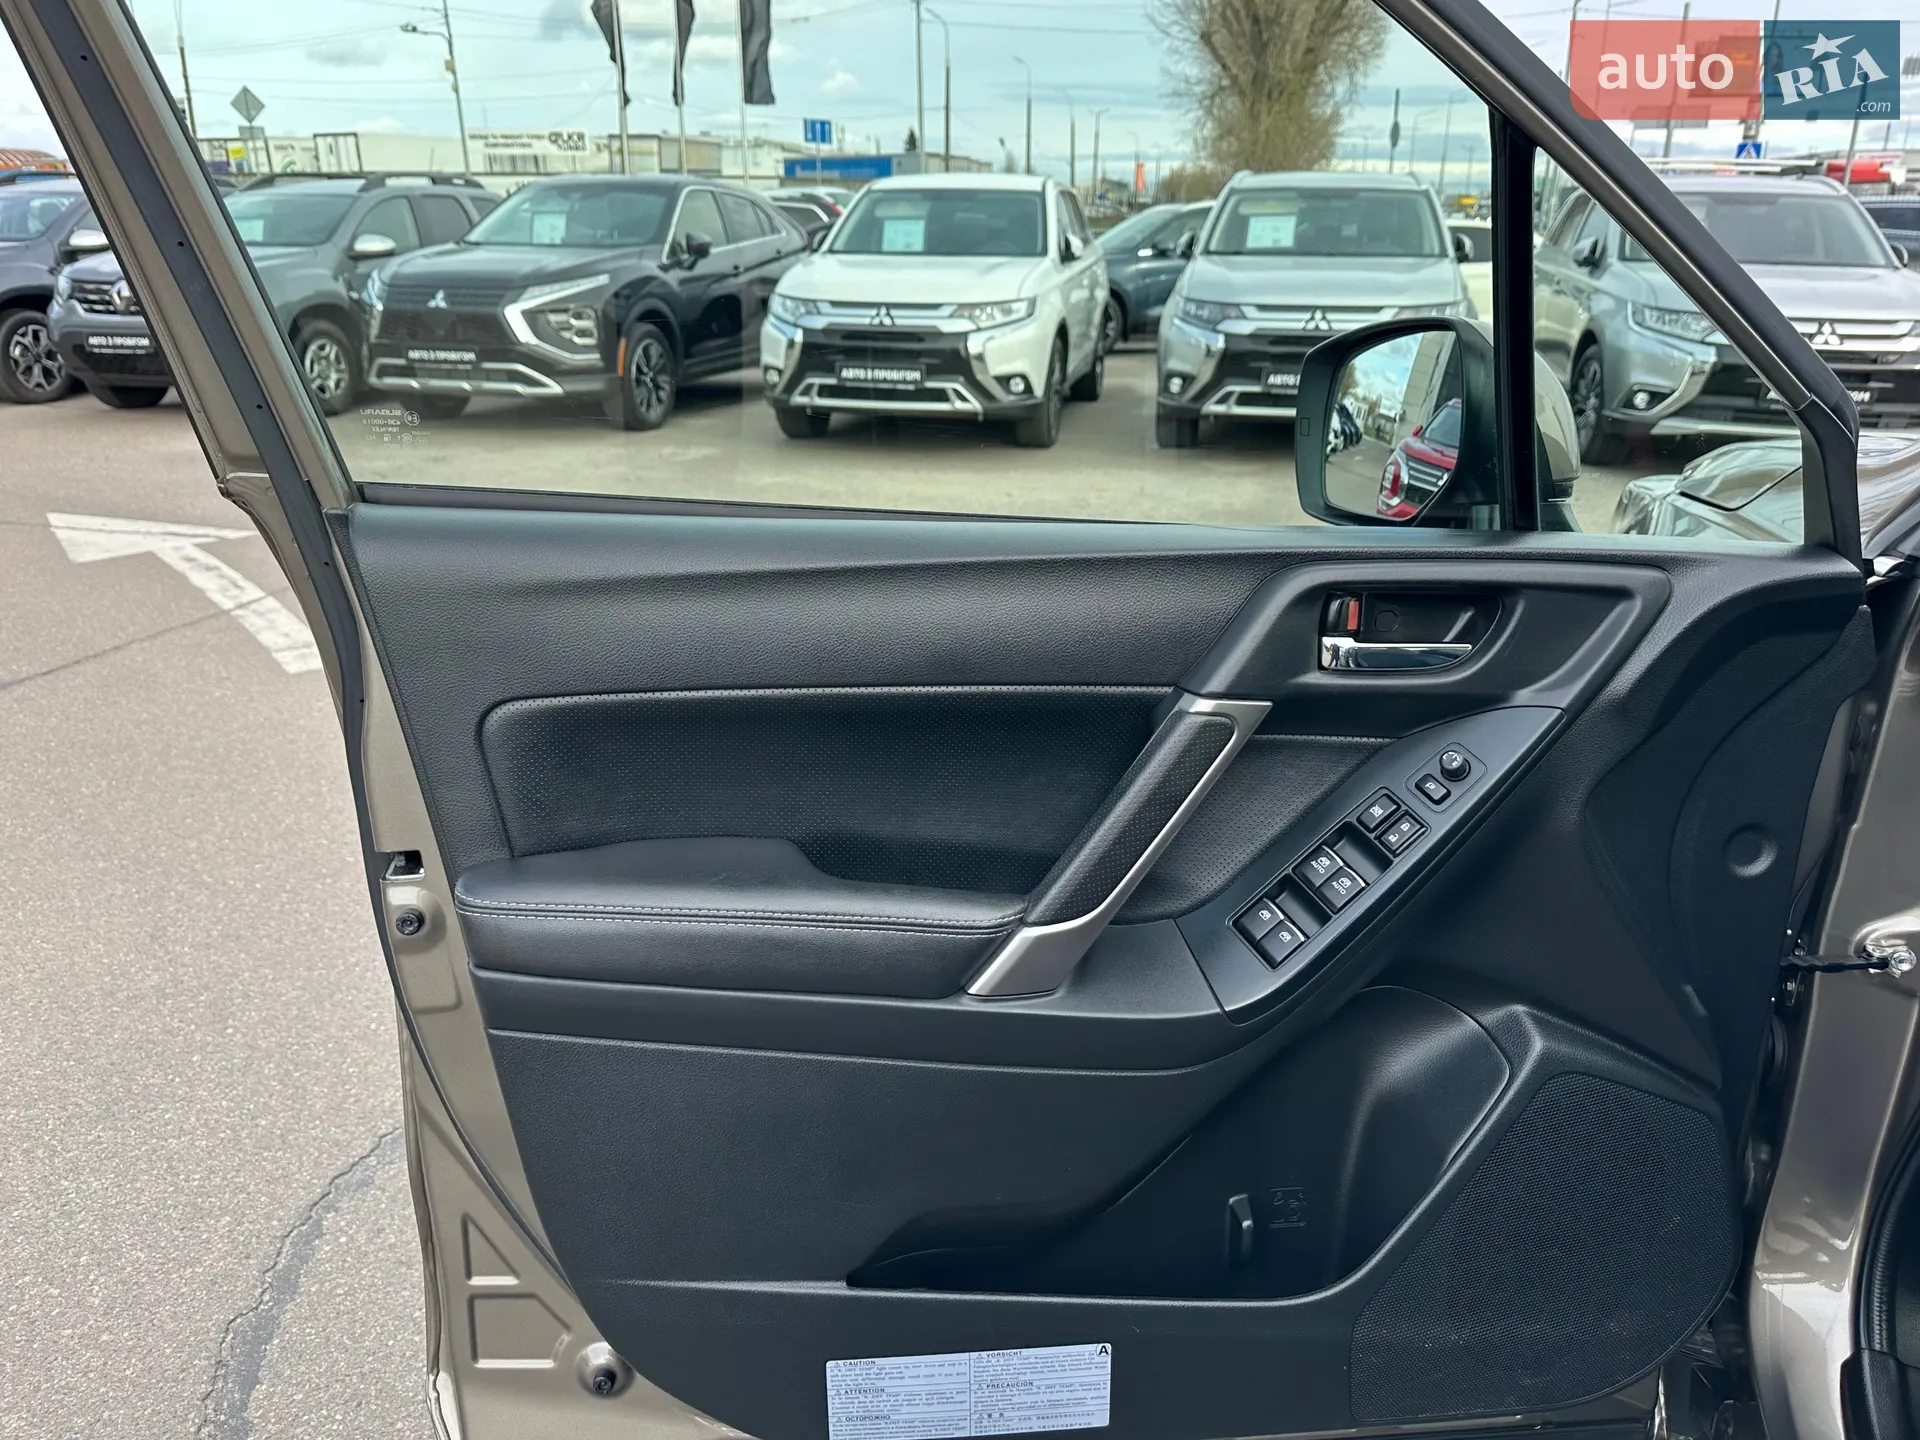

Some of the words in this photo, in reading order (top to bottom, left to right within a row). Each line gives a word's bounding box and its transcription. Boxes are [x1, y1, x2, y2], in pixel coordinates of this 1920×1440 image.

[88, 336, 107, 346] АВТО
[408, 349, 429, 360] АВТО
[841, 367, 866, 380] АВТО
[873, 368, 921, 381] ПРОБІГОМ
[1267, 373, 1296, 386] АВТО
[1310, 860, 1325, 873] AUTO
[1331, 881, 1346, 894] AUTO
[1098, 1345, 1109, 1356] A
[844, 1387, 885, 1395] ATTENTION
[845, 1414, 891, 1423] ОСТОРОЖНО
